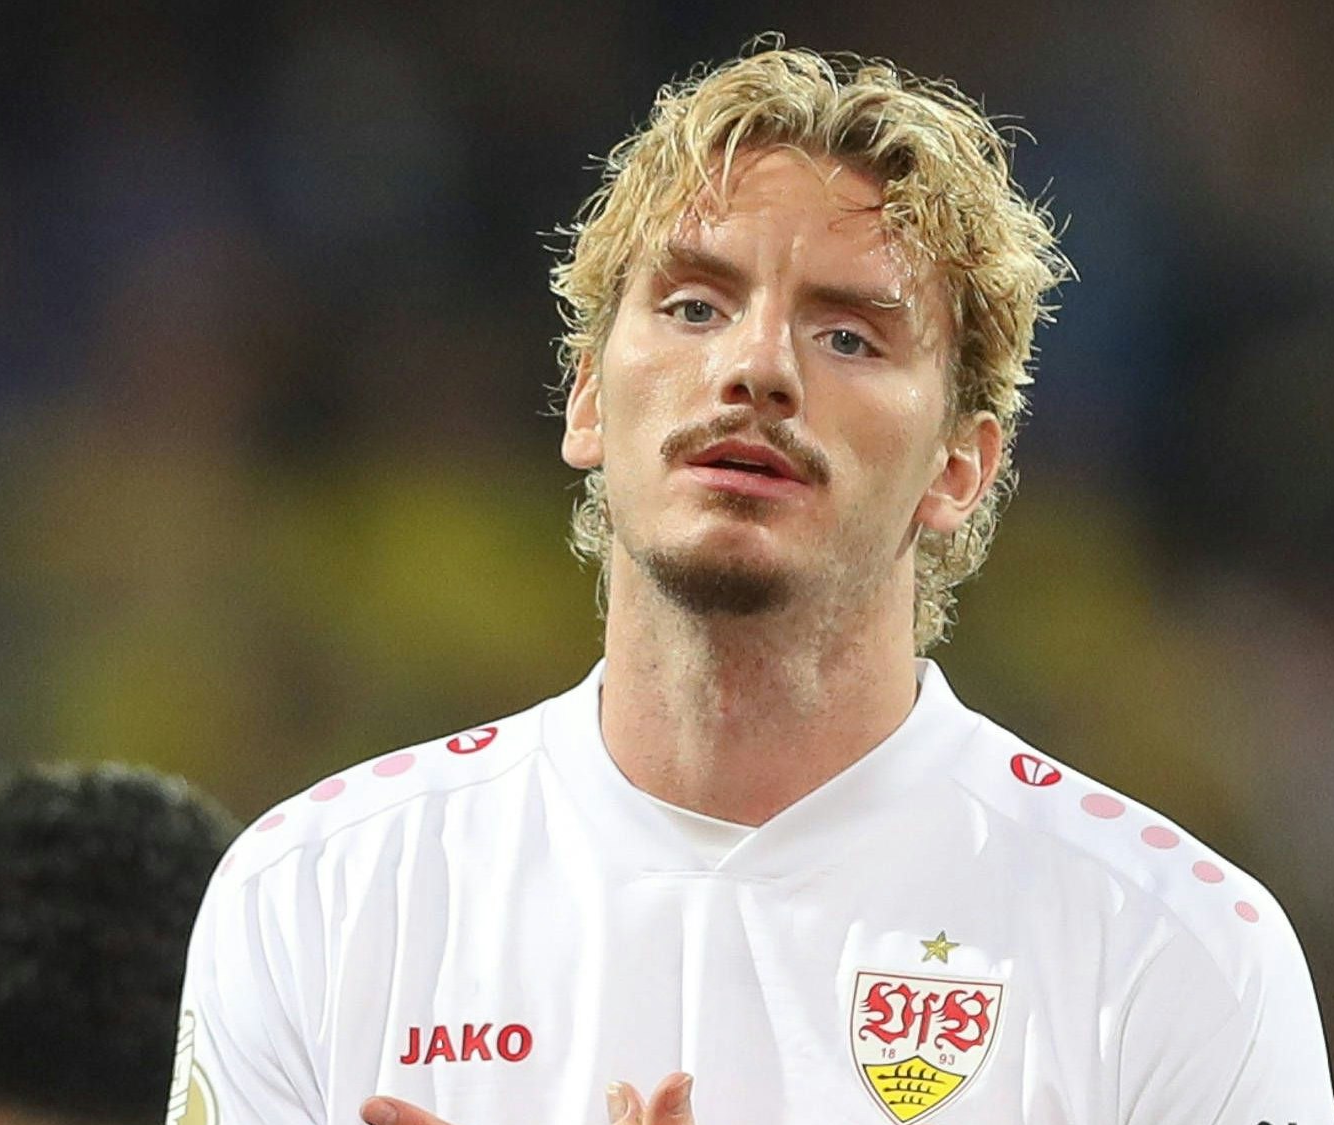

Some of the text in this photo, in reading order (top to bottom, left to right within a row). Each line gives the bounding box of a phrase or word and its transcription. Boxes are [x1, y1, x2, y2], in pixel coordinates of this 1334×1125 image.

[400, 1023, 533, 1065] JAKO
[881, 1047, 956, 1066] 18 93
